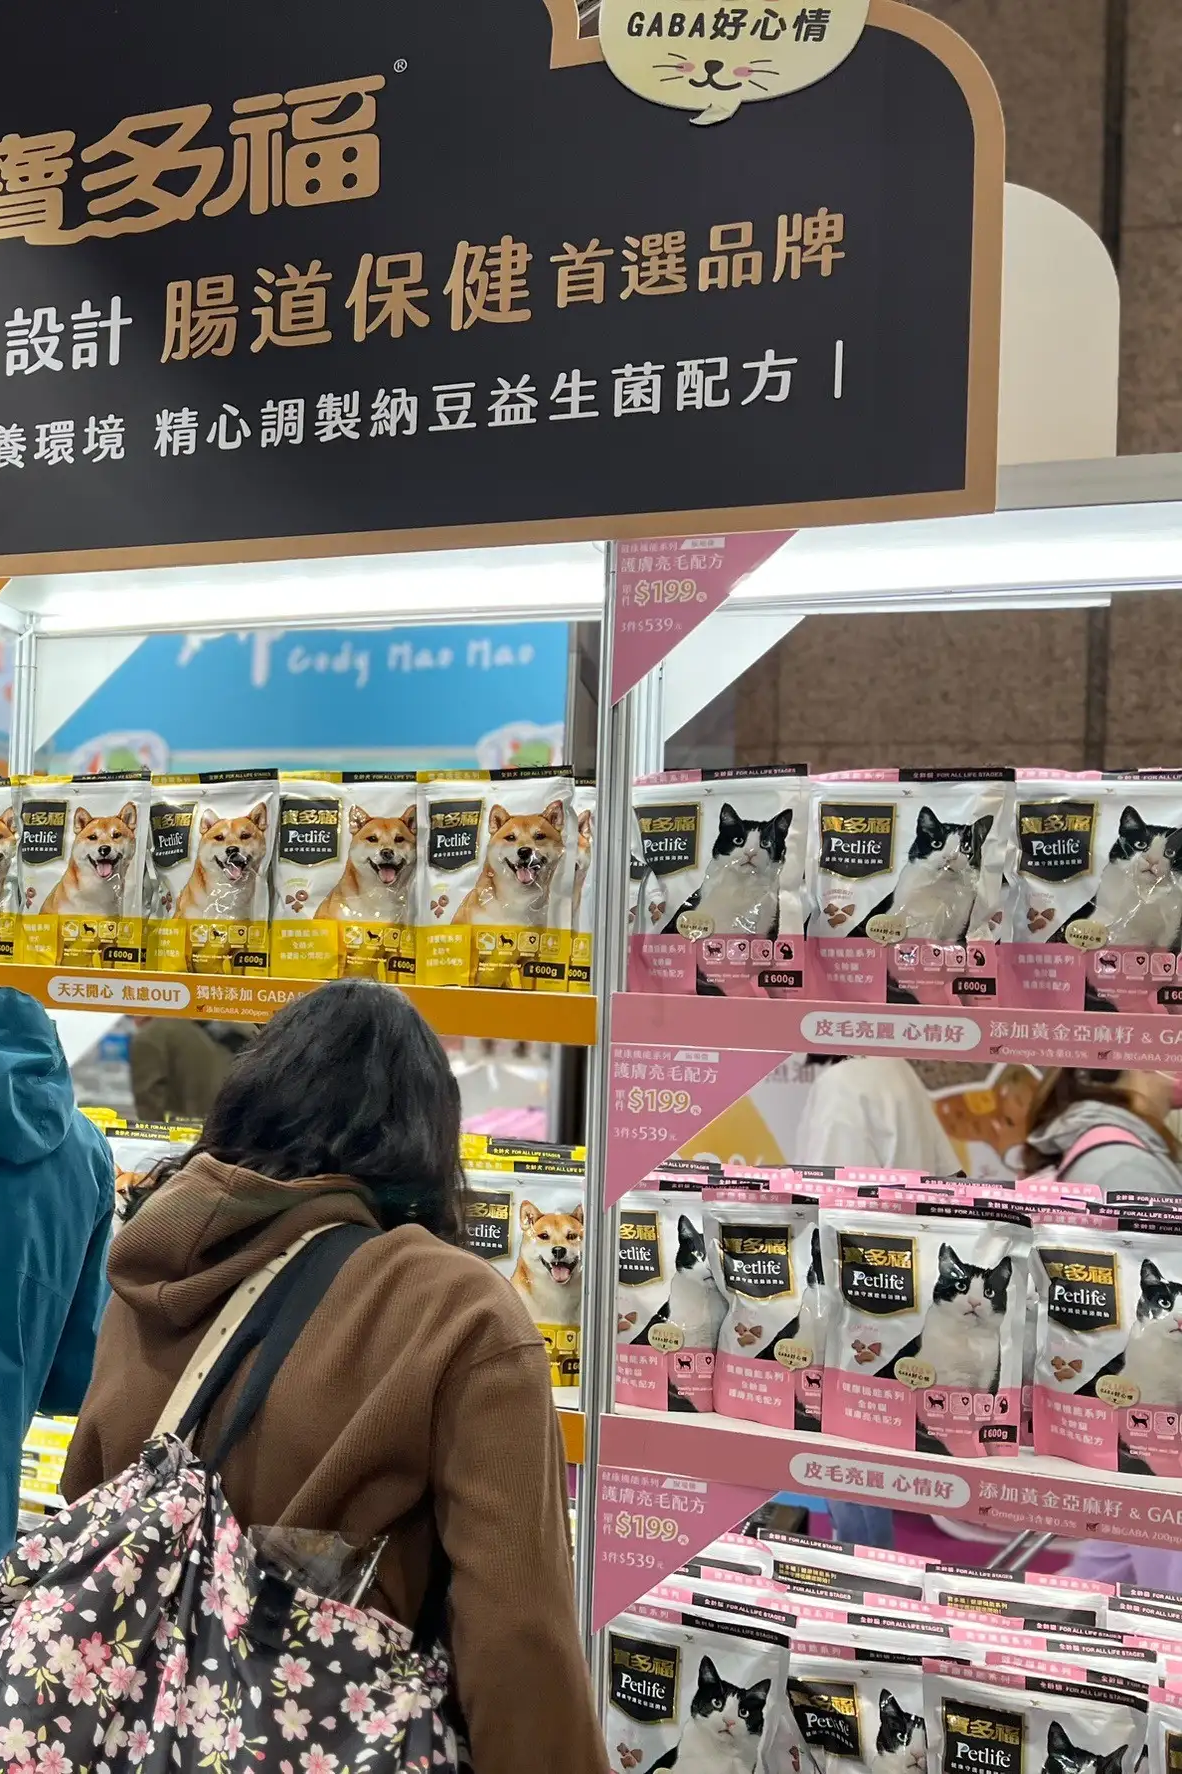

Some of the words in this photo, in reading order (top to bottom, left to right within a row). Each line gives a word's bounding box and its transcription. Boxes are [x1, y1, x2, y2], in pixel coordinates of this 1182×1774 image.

[627, 7, 831, 42] GABA好心情
[153, 348, 799, 457] 精心調製納豆益生菌配方
[621, 553, 724, 572] 護膚亮毛配方
[23, 831, 58, 844] Petlife
[158, 831, 184, 848] Petlife
[287, 830, 331, 844] Petlife
[436, 834, 471, 849] Petlife
[644, 837, 688, 853] Petlife
[830, 837, 882, 855] Petlife
[1031, 838, 1081, 857] Petlife
[243, 955, 264, 966] 600g
[535, 966, 558, 978] 600g
[770, 974, 795, 986] 600g
[57, 982, 114, 999] 天天開心
[121, 985, 181, 1003] 焦慮OUT
[963, 981, 987, 993] 600g
[814, 1019, 895, 1041] 皮毛亮麗
[902, 1022, 966, 1044] 心情好
[989, 1019, 1135, 1044] 添加黃金亞麻籽
[614, 1062, 719, 1084] 護膚亮毛配方
[467, 1203, 510, 1221] 多福
[468, 1223, 501, 1240] etlife
[619, 1223, 656, 1240] 多福
[619, 1246, 651, 1261] etlife
[733, 1260, 781, 1276] Petlife
[852, 1270, 905, 1290] Petlife
[1054, 1285, 1107, 1307] Petlife
[986, 1429, 1009, 1440] 600g
[803, 1460, 886, 1490] 皮毛亮麗
[891, 1471, 955, 1500] 心情好
[978, 1479, 1123, 1519] 添加黃金亞麻籽
[1129, 1507, 1141, 1520] &
[601, 1485, 708, 1514] 護膚亮毛配方
[620, 1673, 666, 1700] Petlife
[805, 1712, 850, 1736] Petlife
[955, 1741, 1012, 1768] Petlife
